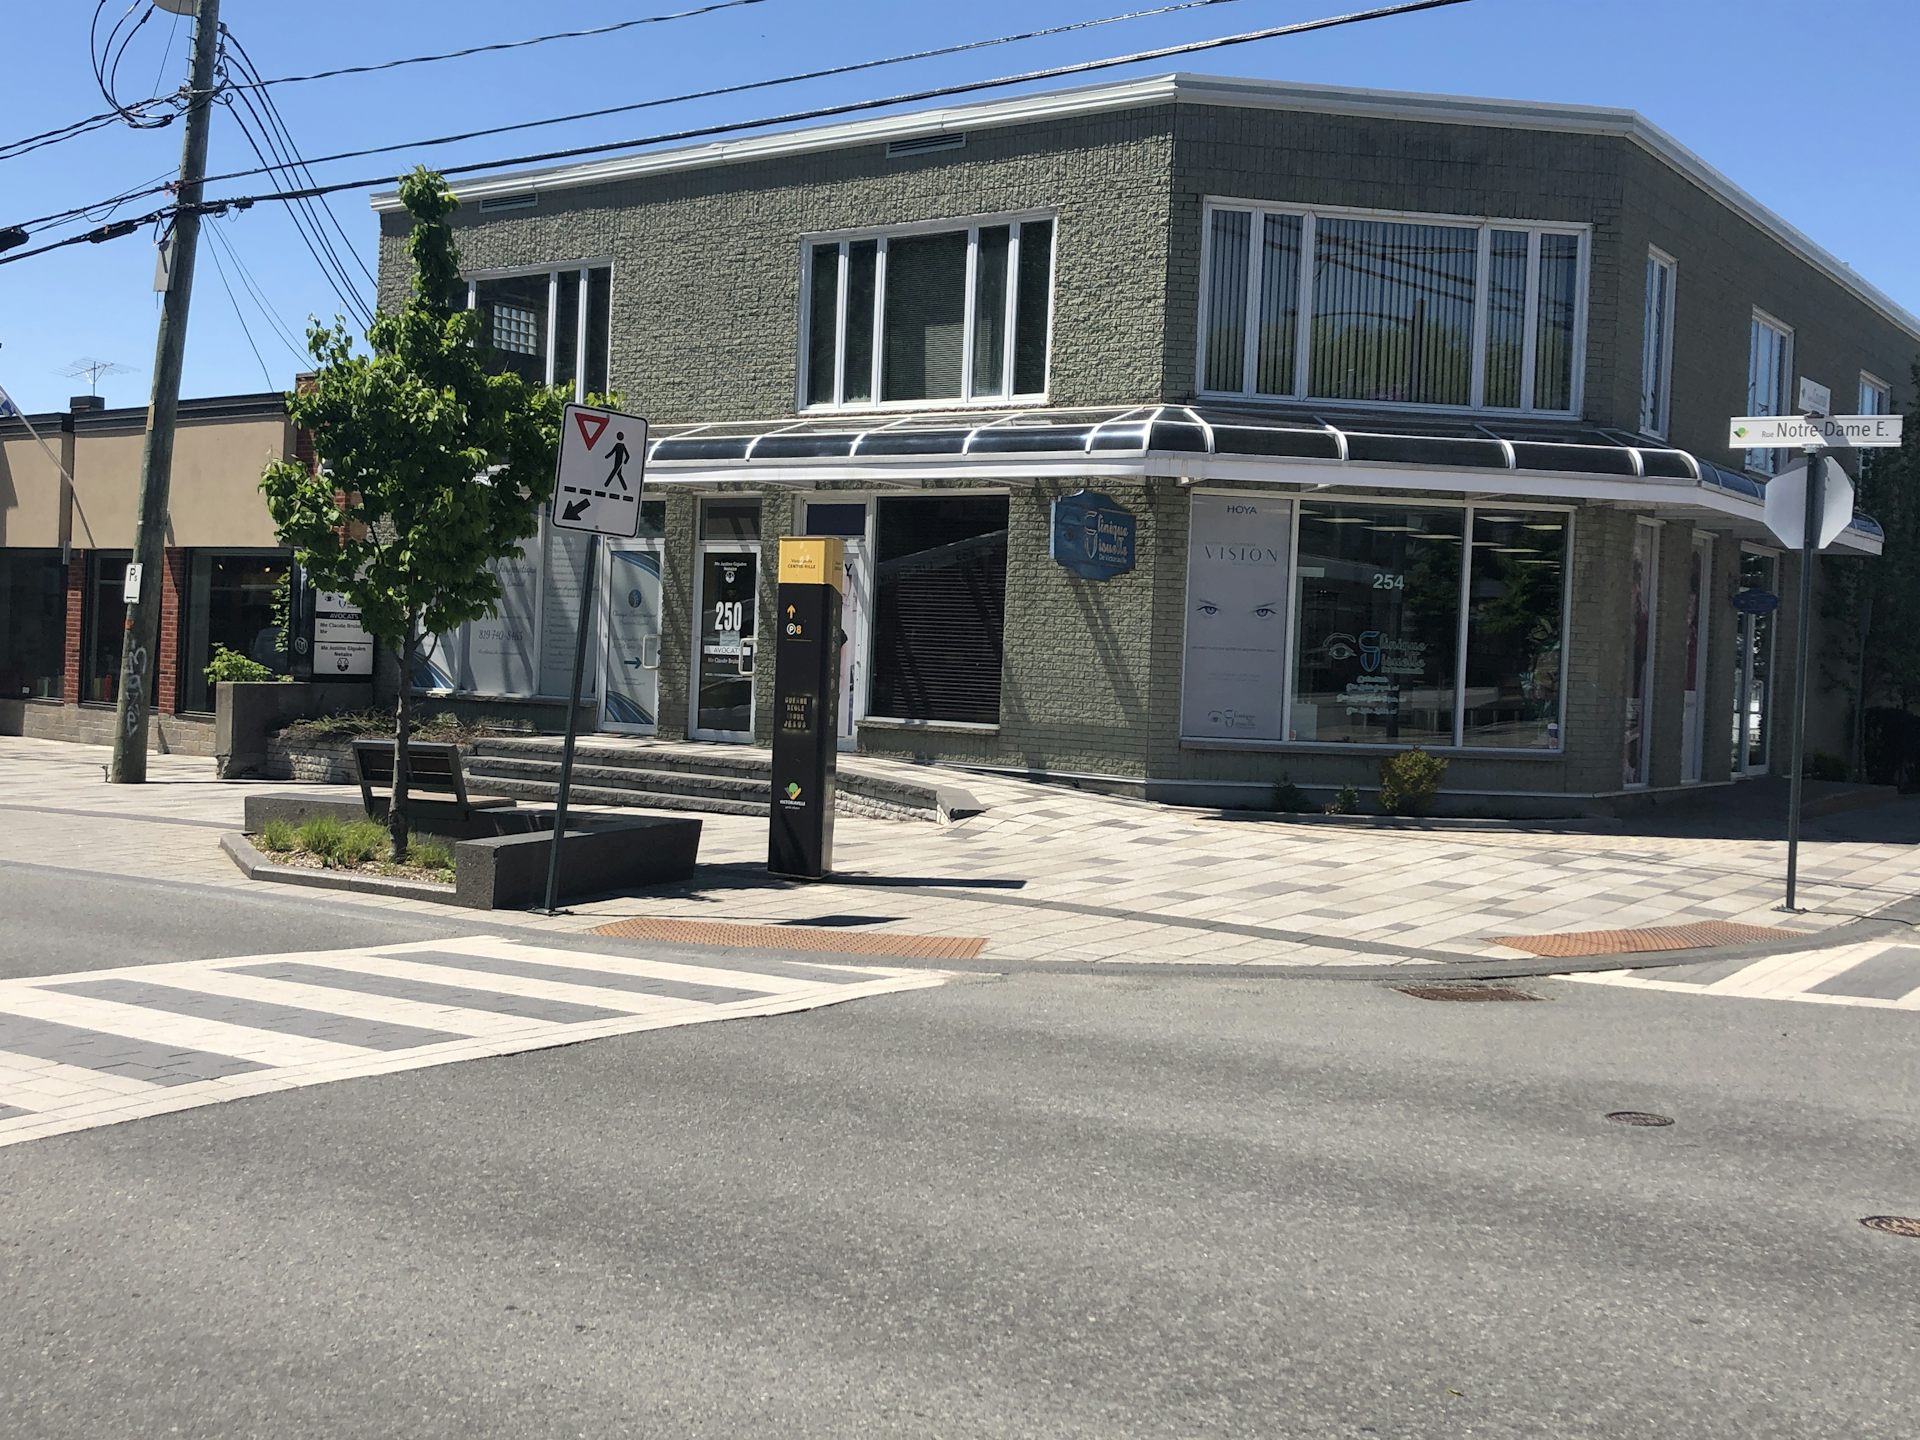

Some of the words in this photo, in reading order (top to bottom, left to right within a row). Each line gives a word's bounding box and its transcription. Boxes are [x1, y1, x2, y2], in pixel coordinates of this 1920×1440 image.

[1776, 421, 1871, 438] Notre-Dame
[1876, 421, 1889, 437] E.
[1227, 505, 1257, 514] HOYA
[1204, 545, 1278, 562] VISION
[1373, 573, 1405, 590] 254
[715, 601, 742, 631] 250
